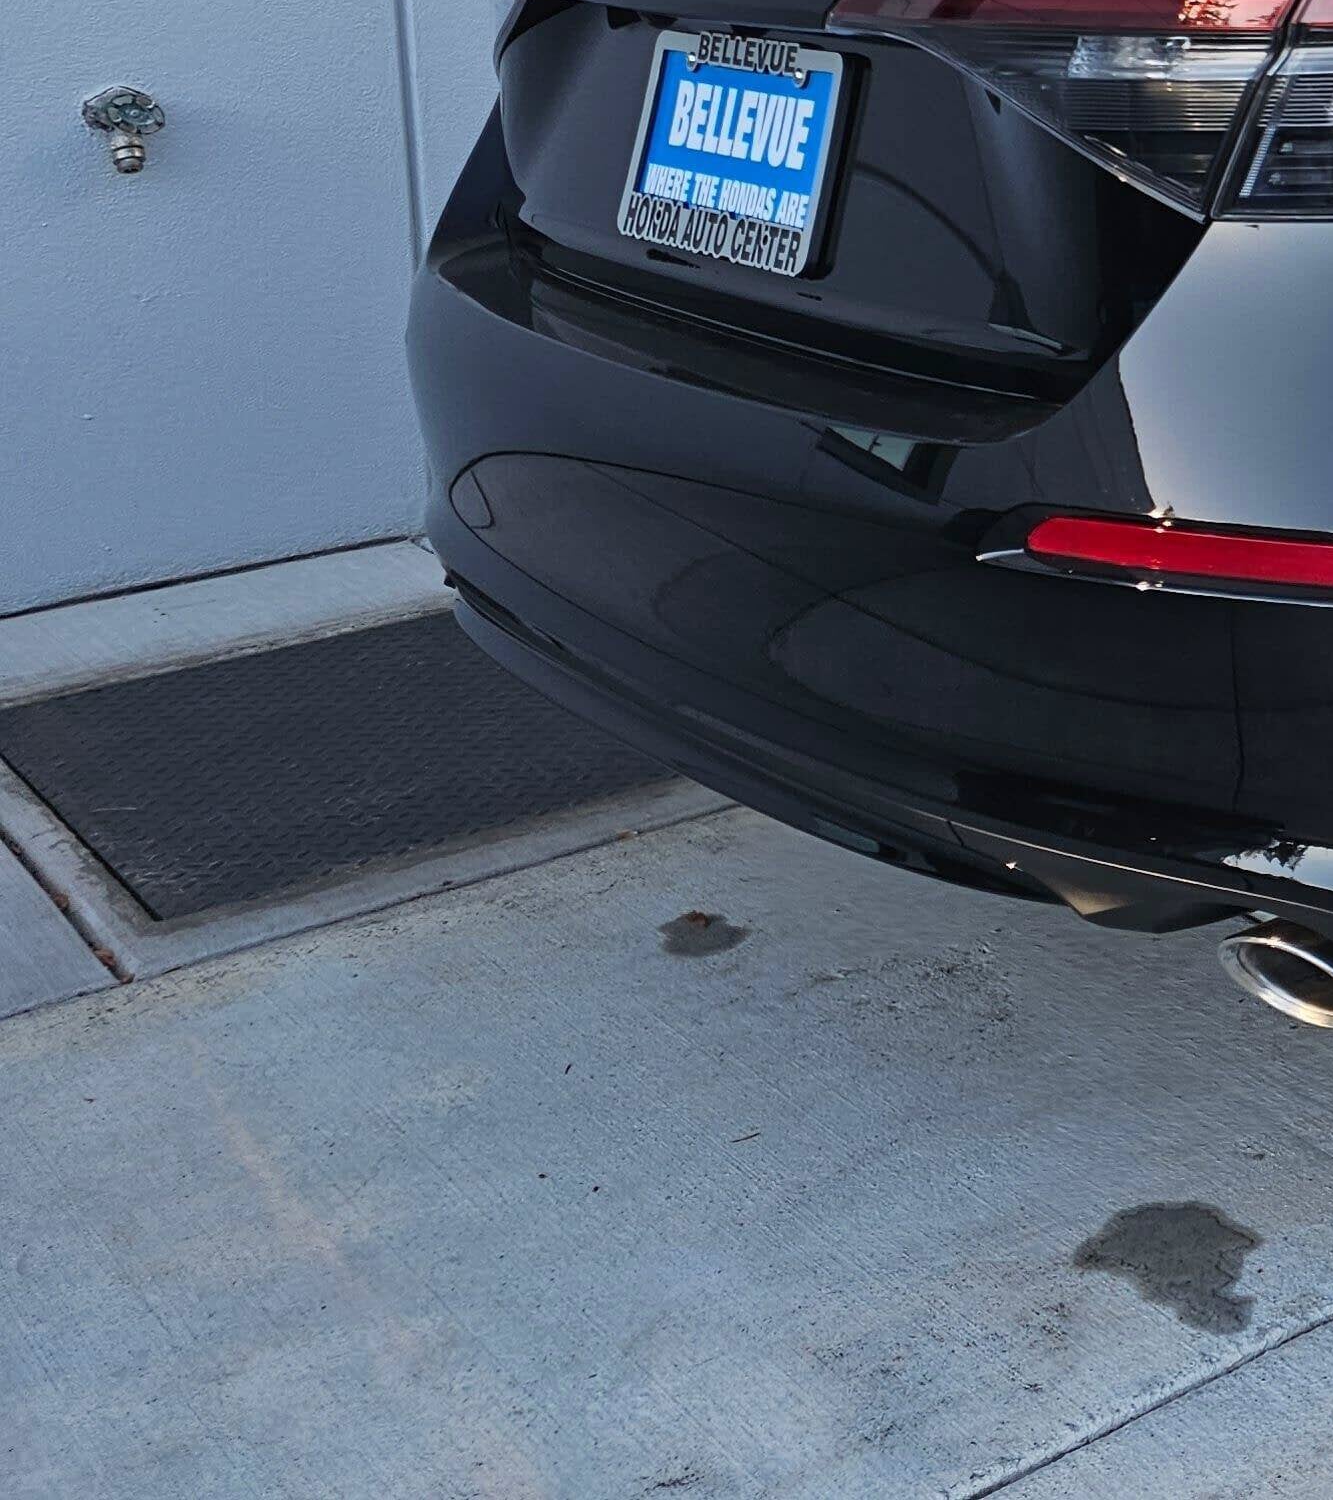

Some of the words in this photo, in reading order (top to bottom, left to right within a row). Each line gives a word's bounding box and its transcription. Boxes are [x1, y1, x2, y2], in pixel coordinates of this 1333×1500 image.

[699, 33, 799, 74] BELLEVUE
[668, 79, 815, 171] BELLEVUE
[645, 163, 691, 200] WHERE
[692, 173, 719, 206] THE
[720, 178, 776, 220] HONDAS
[777, 191, 810, 228] ARE
[623, 195, 680, 245] HONDA
[684, 206, 730, 256] AUTO
[731, 220, 802, 274] CENTER
